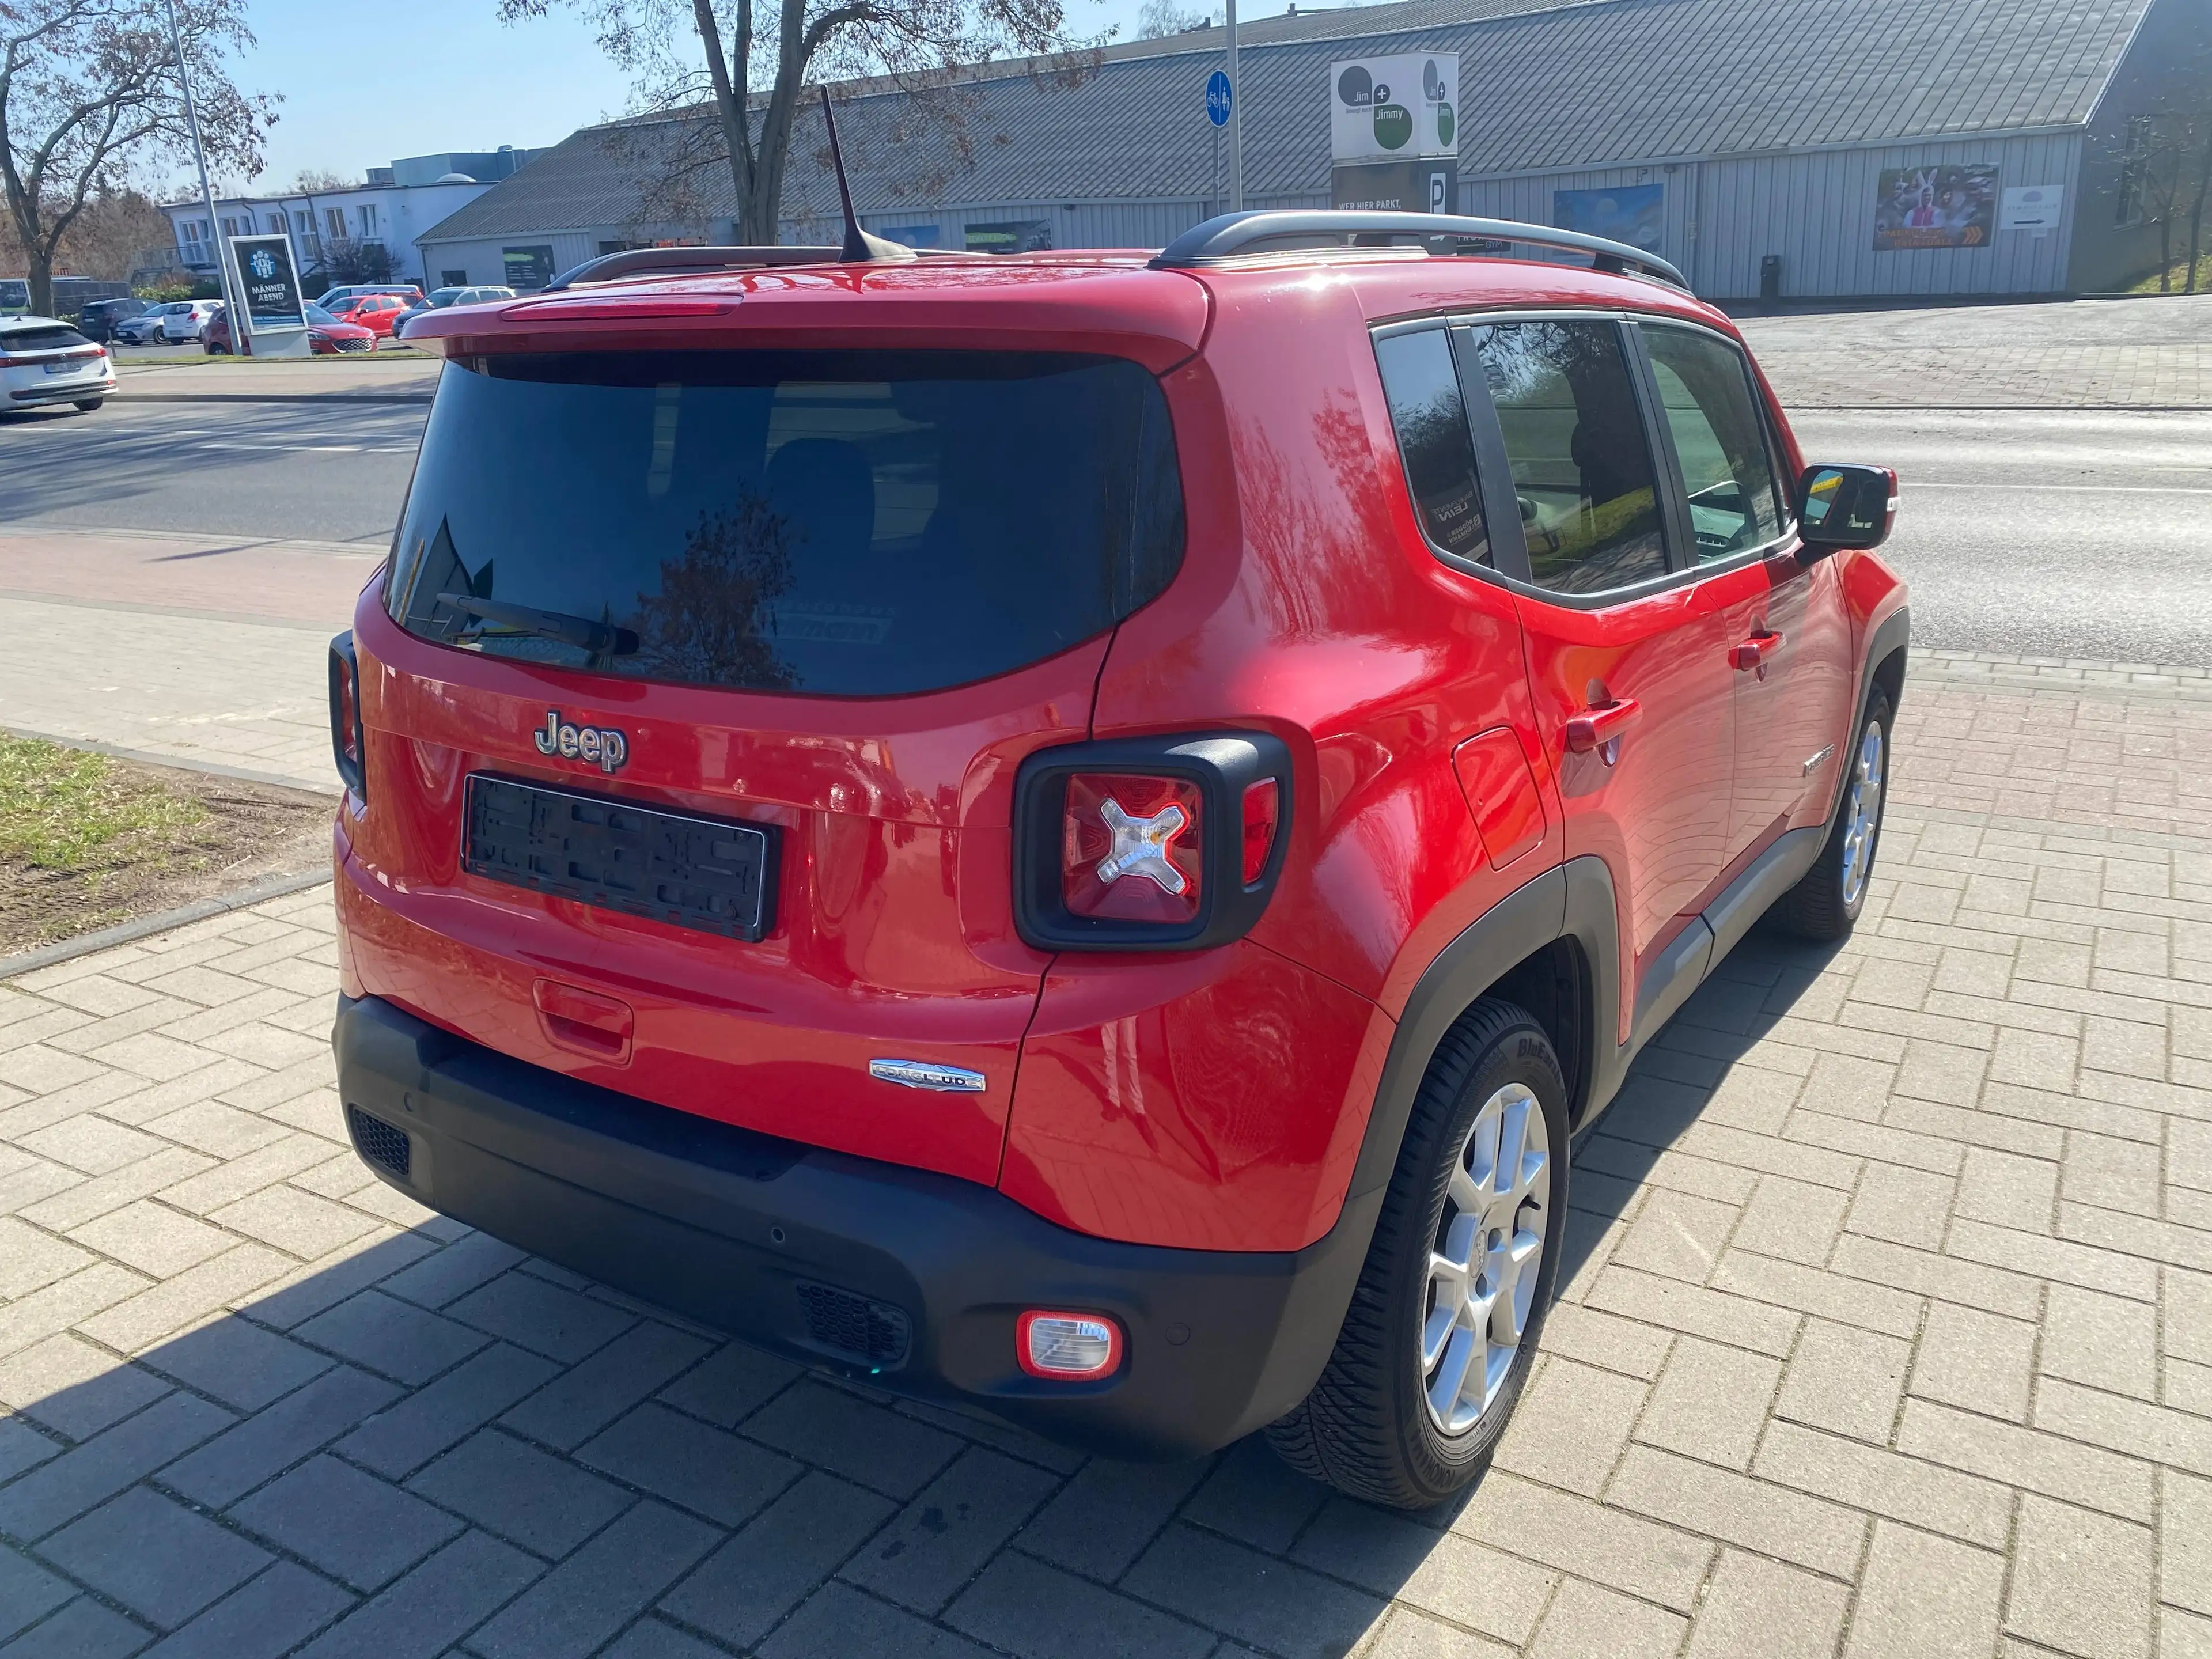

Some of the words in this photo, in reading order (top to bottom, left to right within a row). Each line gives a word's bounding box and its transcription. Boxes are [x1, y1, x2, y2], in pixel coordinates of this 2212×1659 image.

[1354, 91, 1369, 102] Jim
[1376, 108, 1403, 120] Jimmy
[1432, 179, 1444, 213] P
[1357, 201, 1374, 210] HIER
[1376, 199, 1401, 210] PARKT,
[1486, 240, 1502, 249] GYM
[251, 283, 286, 294] MÄNNER
[257, 292, 284, 302] ABEND
[535, 710, 629, 774] Jeep
[875, 1066, 983, 1088] LONGITUDE
